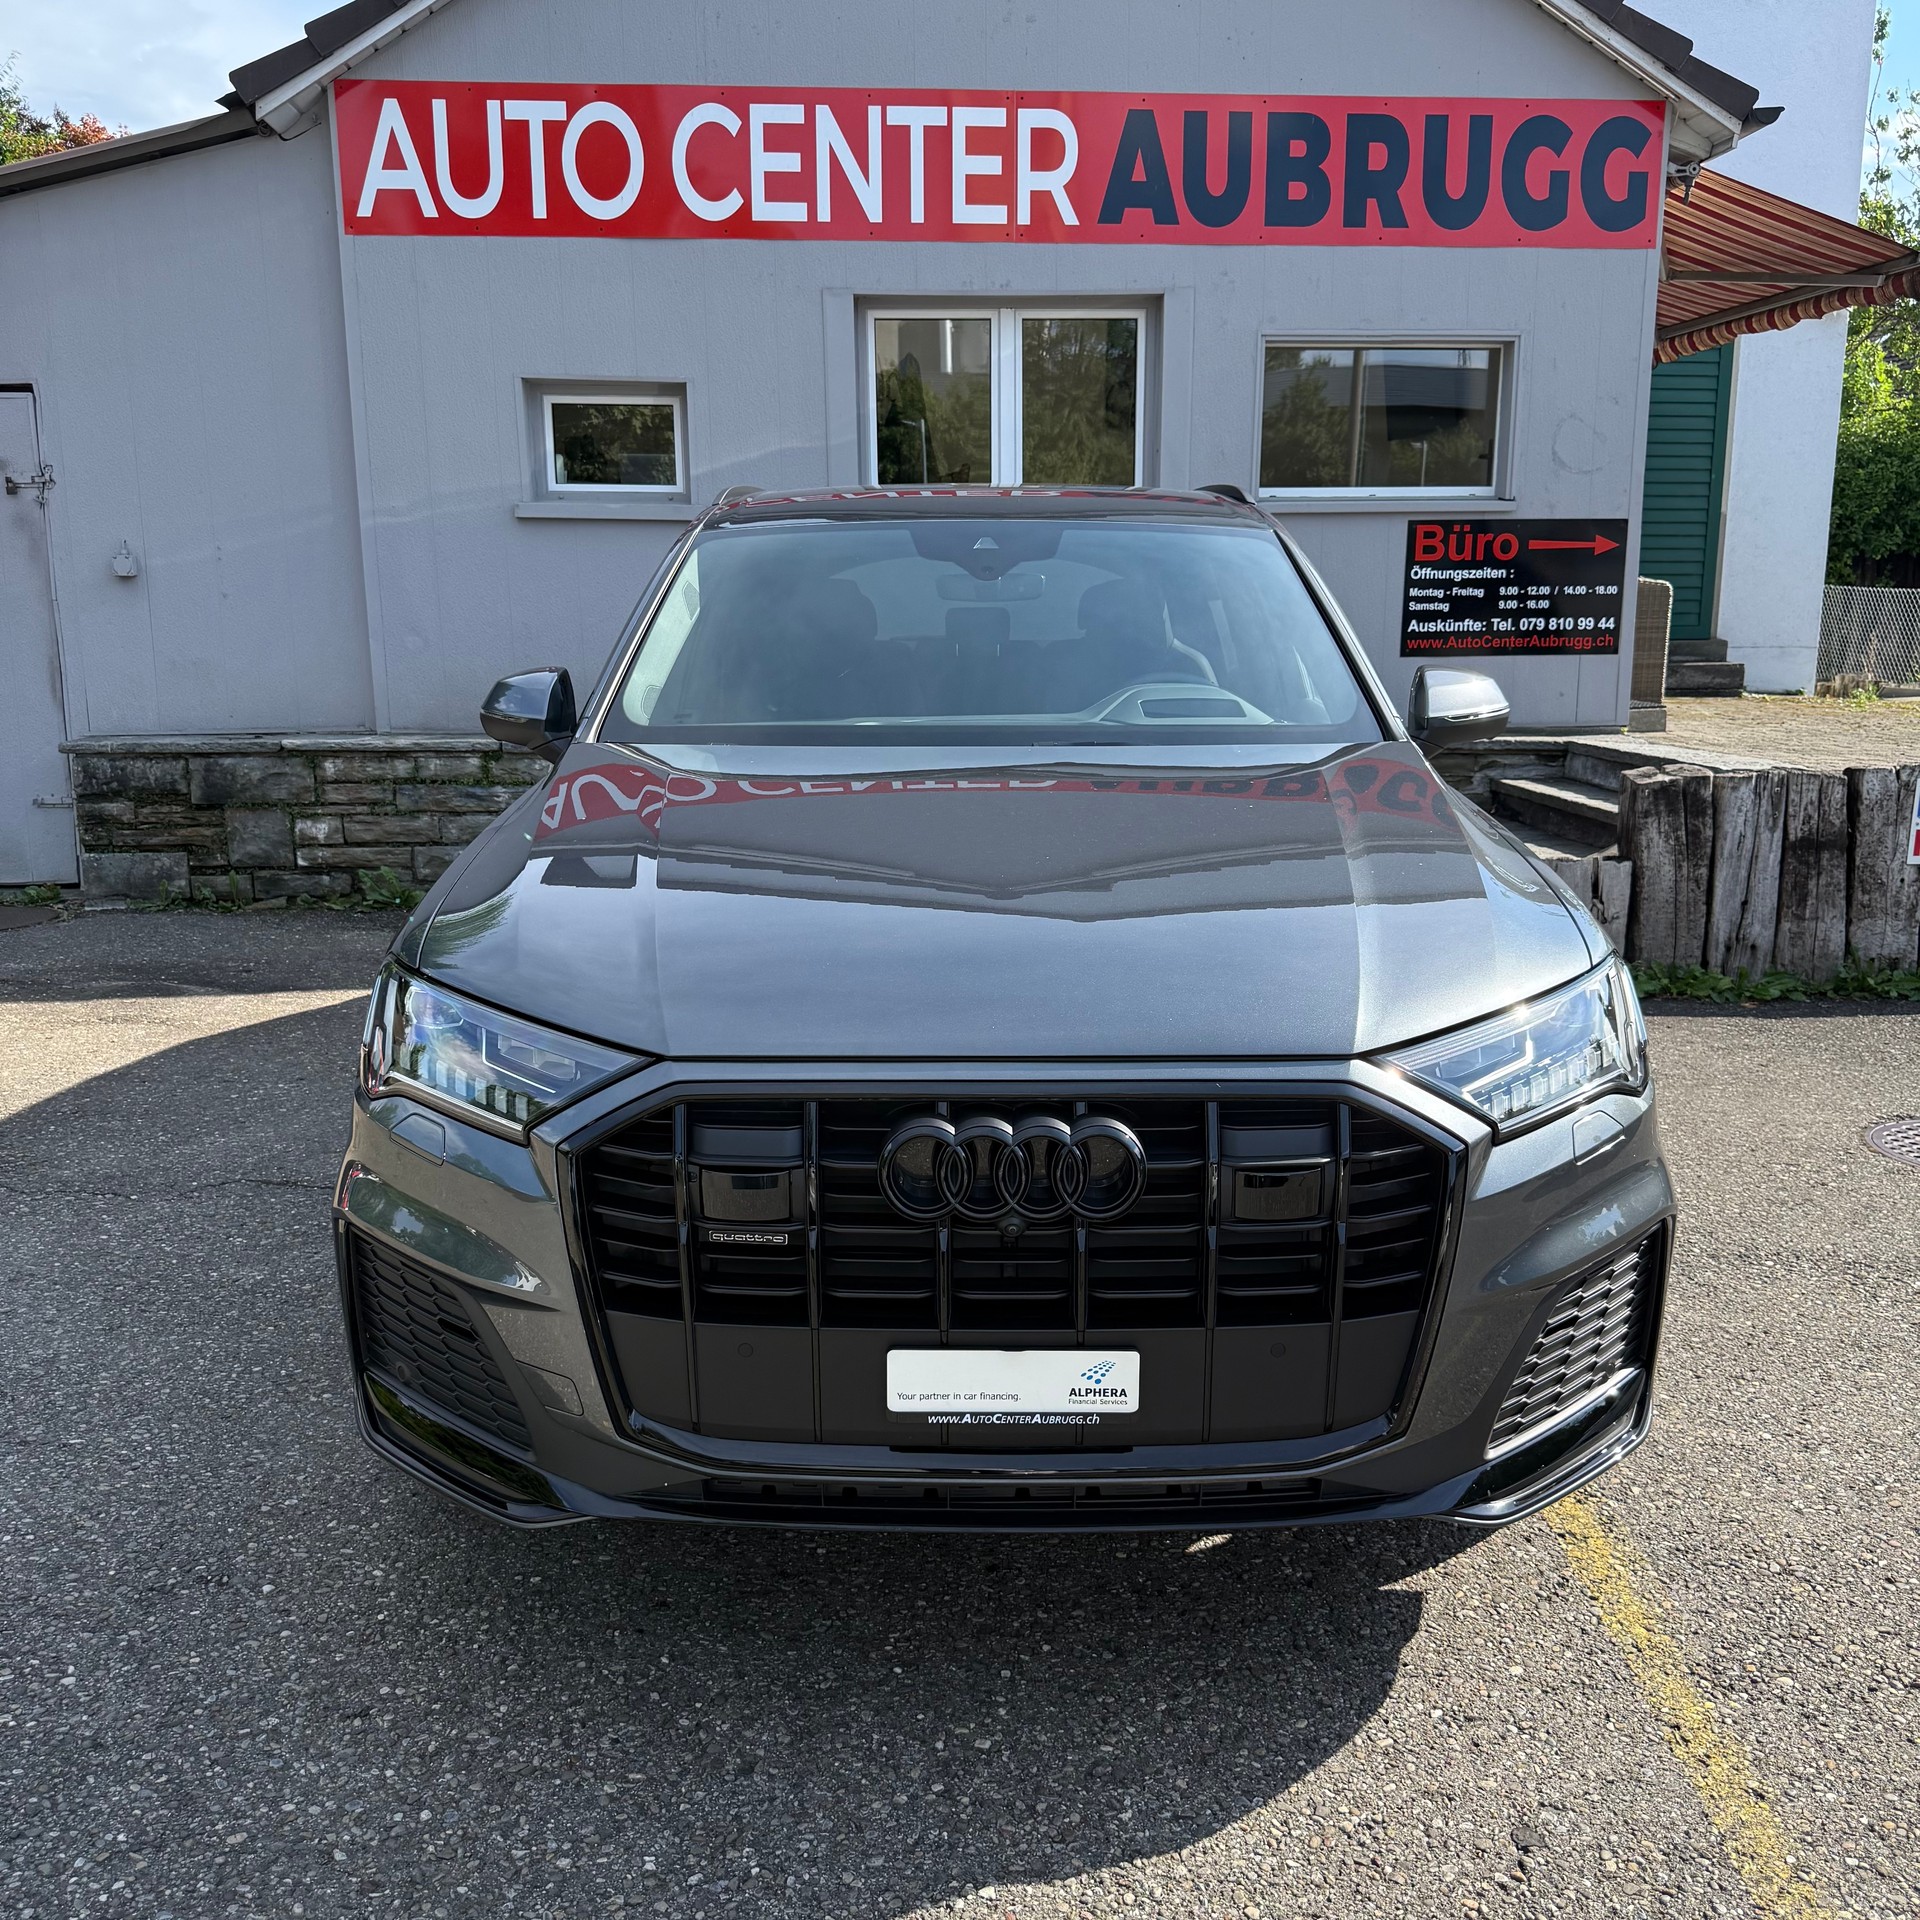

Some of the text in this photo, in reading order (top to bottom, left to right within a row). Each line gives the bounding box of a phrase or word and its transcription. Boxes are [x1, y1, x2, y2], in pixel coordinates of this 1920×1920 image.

[356, 97, 1653, 233] AUTO CENTER AUBRUGG
[1414, 524, 1520, 562] Büro
[1410, 565, 1507, 582] Öffnungszeiten
[1409, 587, 1445, 599] Montag
[1452, 586, 1485, 598] Freitag
[1499, 586, 1519, 596] 9.00
[1526, 585, 1551, 596] 12.00
[1563, 585, 1587, 595] 14.00
[1594, 585, 1618, 595] 18.00
[1408, 601, 1450, 612] Samstag
[1498, 600, 1518, 610] 9.00
[1526, 600, 1550, 610] 16.00
[1407, 616, 1616, 632] Auskünfte: Tel. 079 810 99 44
[1407, 634, 1615, 649] www.AutoCenterAubrugg.ch
[712, 1232, 784, 1243] quattro
[897, 1391, 1022, 1402] Your partner in car financing.
[1069, 1387, 1128, 1398] ALPHERA
[1099, 1398, 1128, 1406] Services
